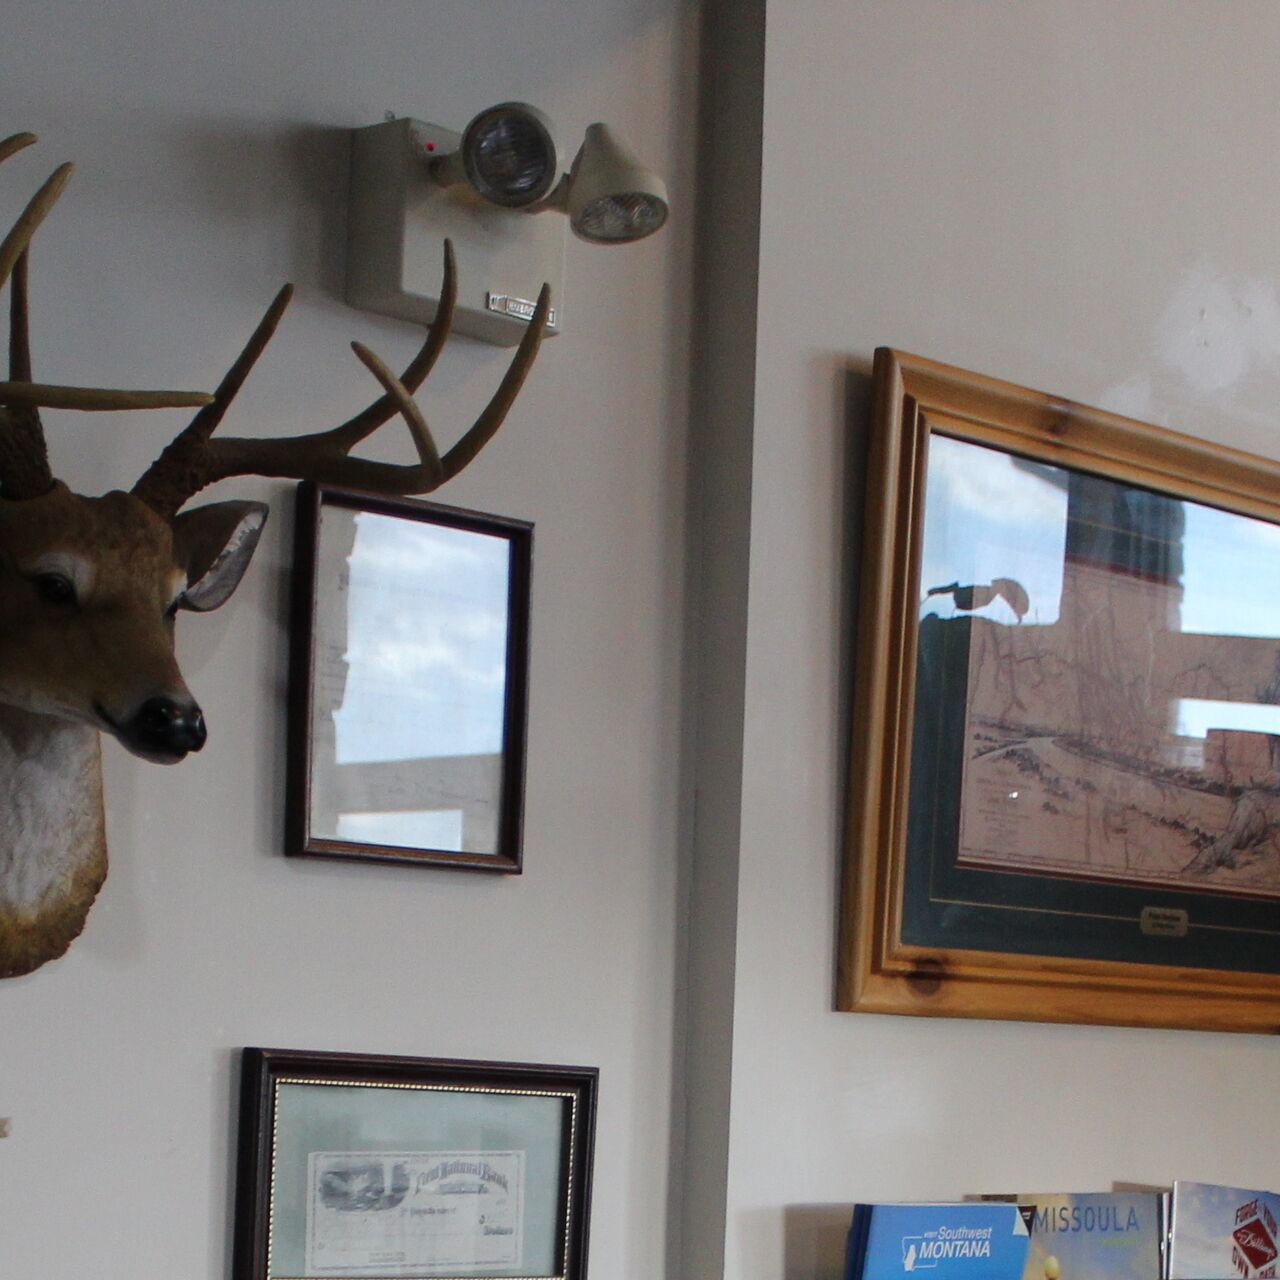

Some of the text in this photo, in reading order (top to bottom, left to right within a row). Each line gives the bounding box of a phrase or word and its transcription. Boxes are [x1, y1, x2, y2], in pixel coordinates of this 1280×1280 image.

[1033, 1206, 1140, 1233] MISSOULA
[938, 1226, 993, 1240] Southwest
[919, 1241, 991, 1259] MONTANA
